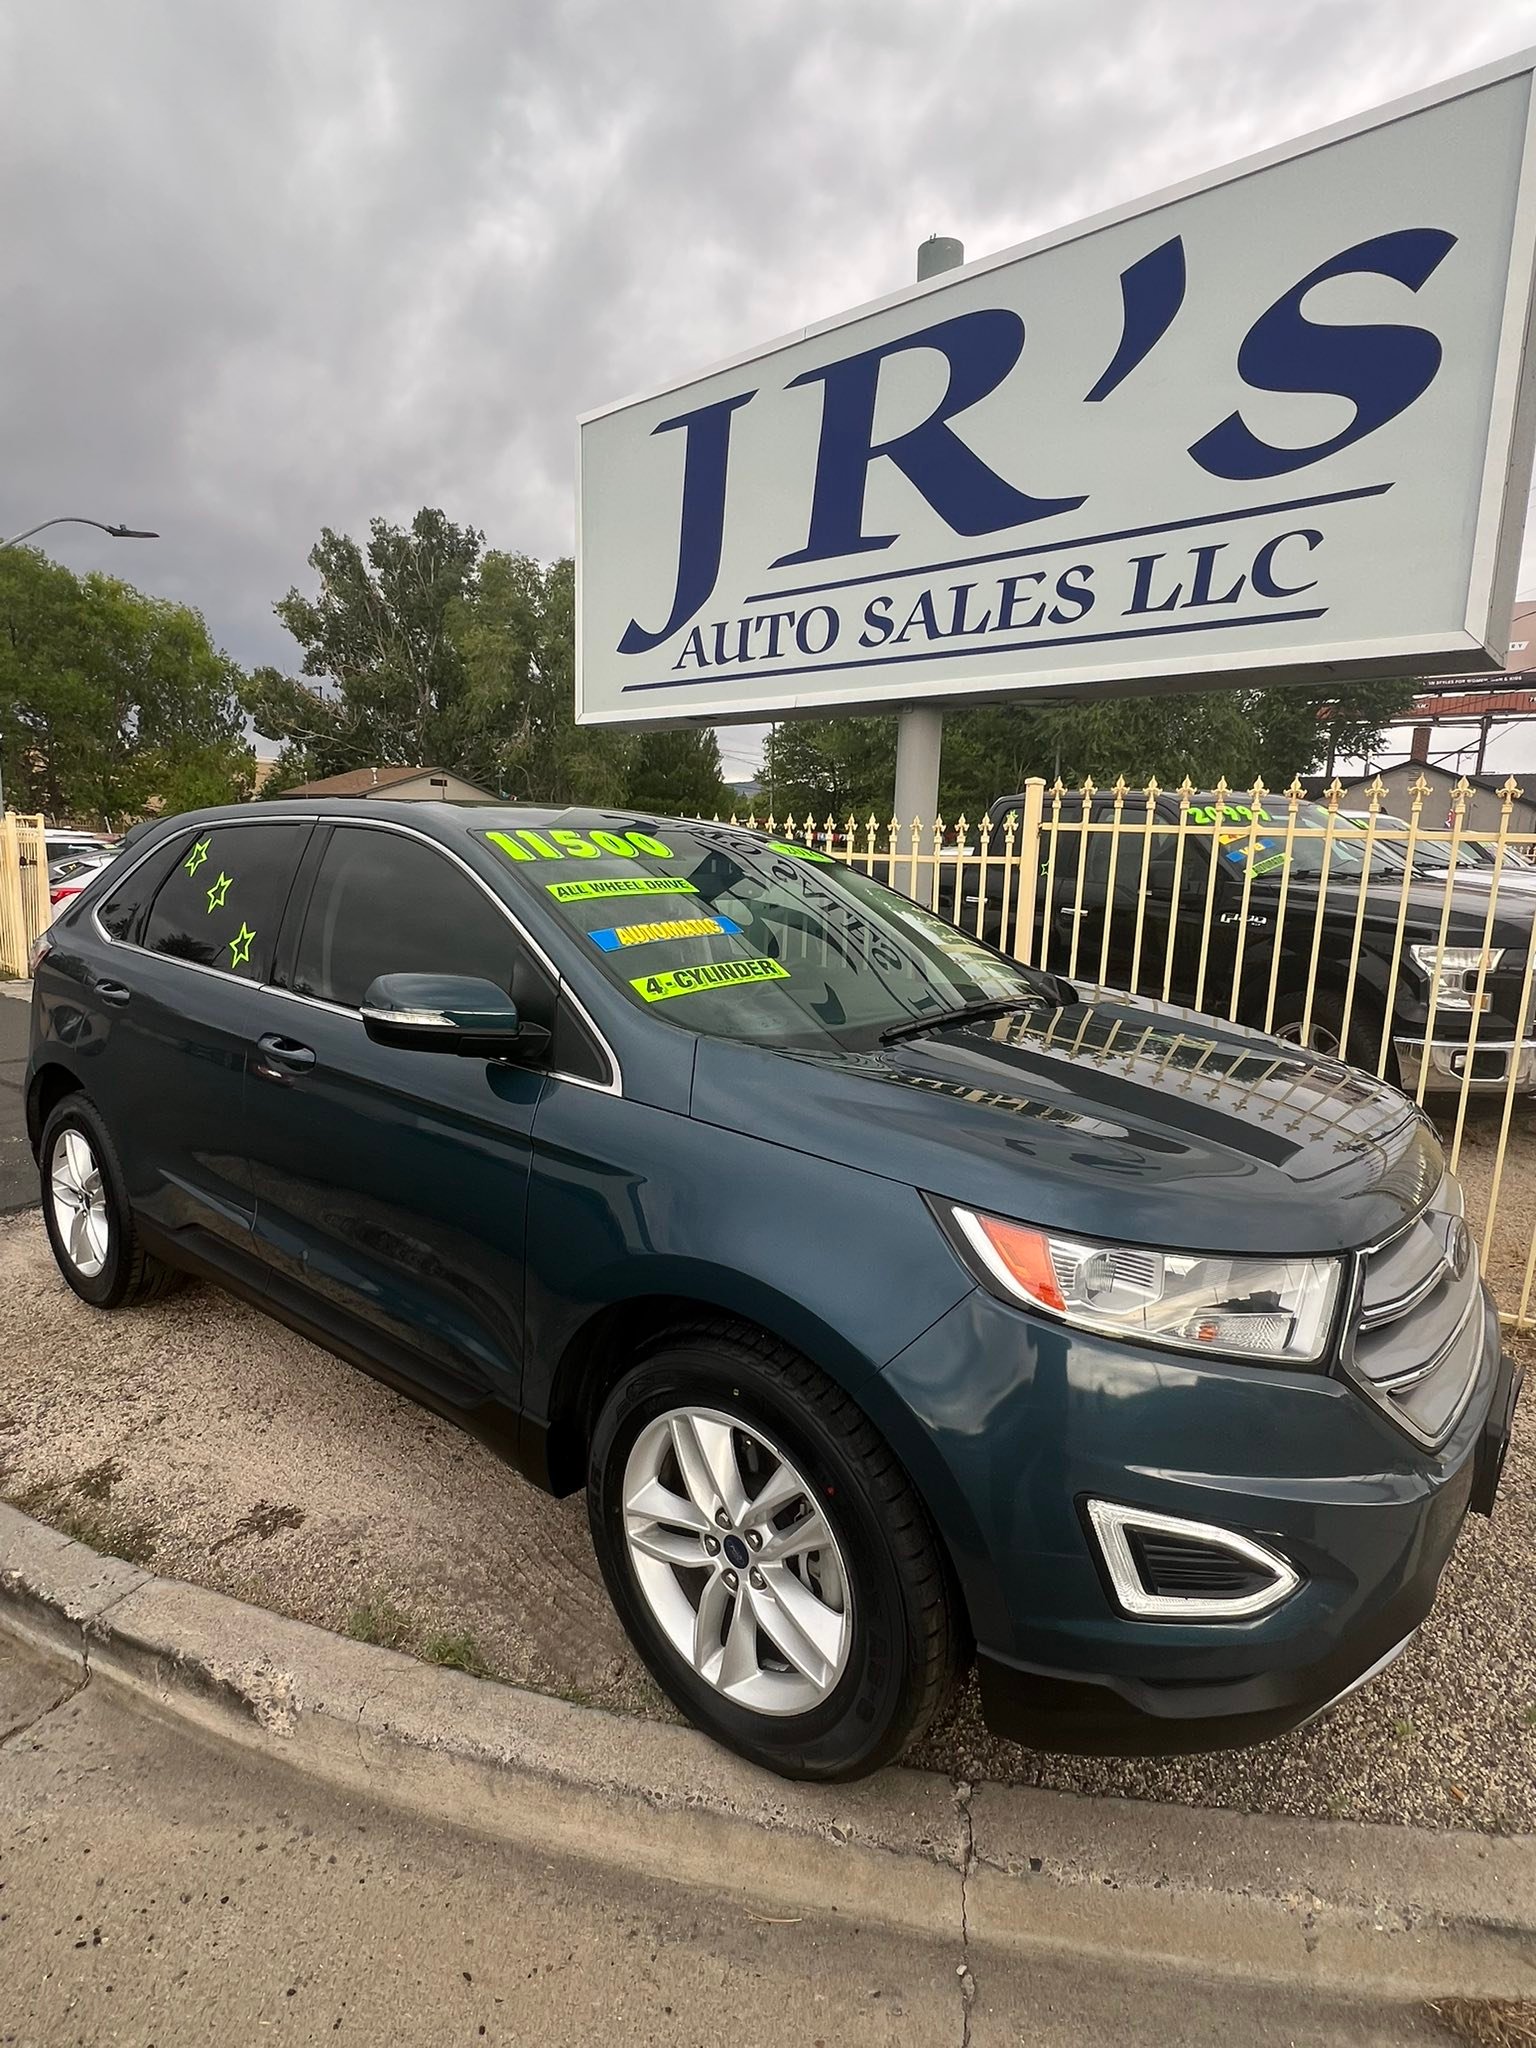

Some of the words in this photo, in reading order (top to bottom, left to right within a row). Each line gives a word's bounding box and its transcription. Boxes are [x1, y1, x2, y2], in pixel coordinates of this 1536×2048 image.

[672, 605, 842, 670] AUTO
[857, 565, 1096, 651] SALES
[1121, 529, 1325, 617] LLC
[485, 829, 674, 861] 11500
[556, 886, 588, 898] ALL
[588, 880, 643, 894] WHEEL
[643, 877, 688, 891] DRIVE
[615, 917, 725, 947] AUTOMATIC
